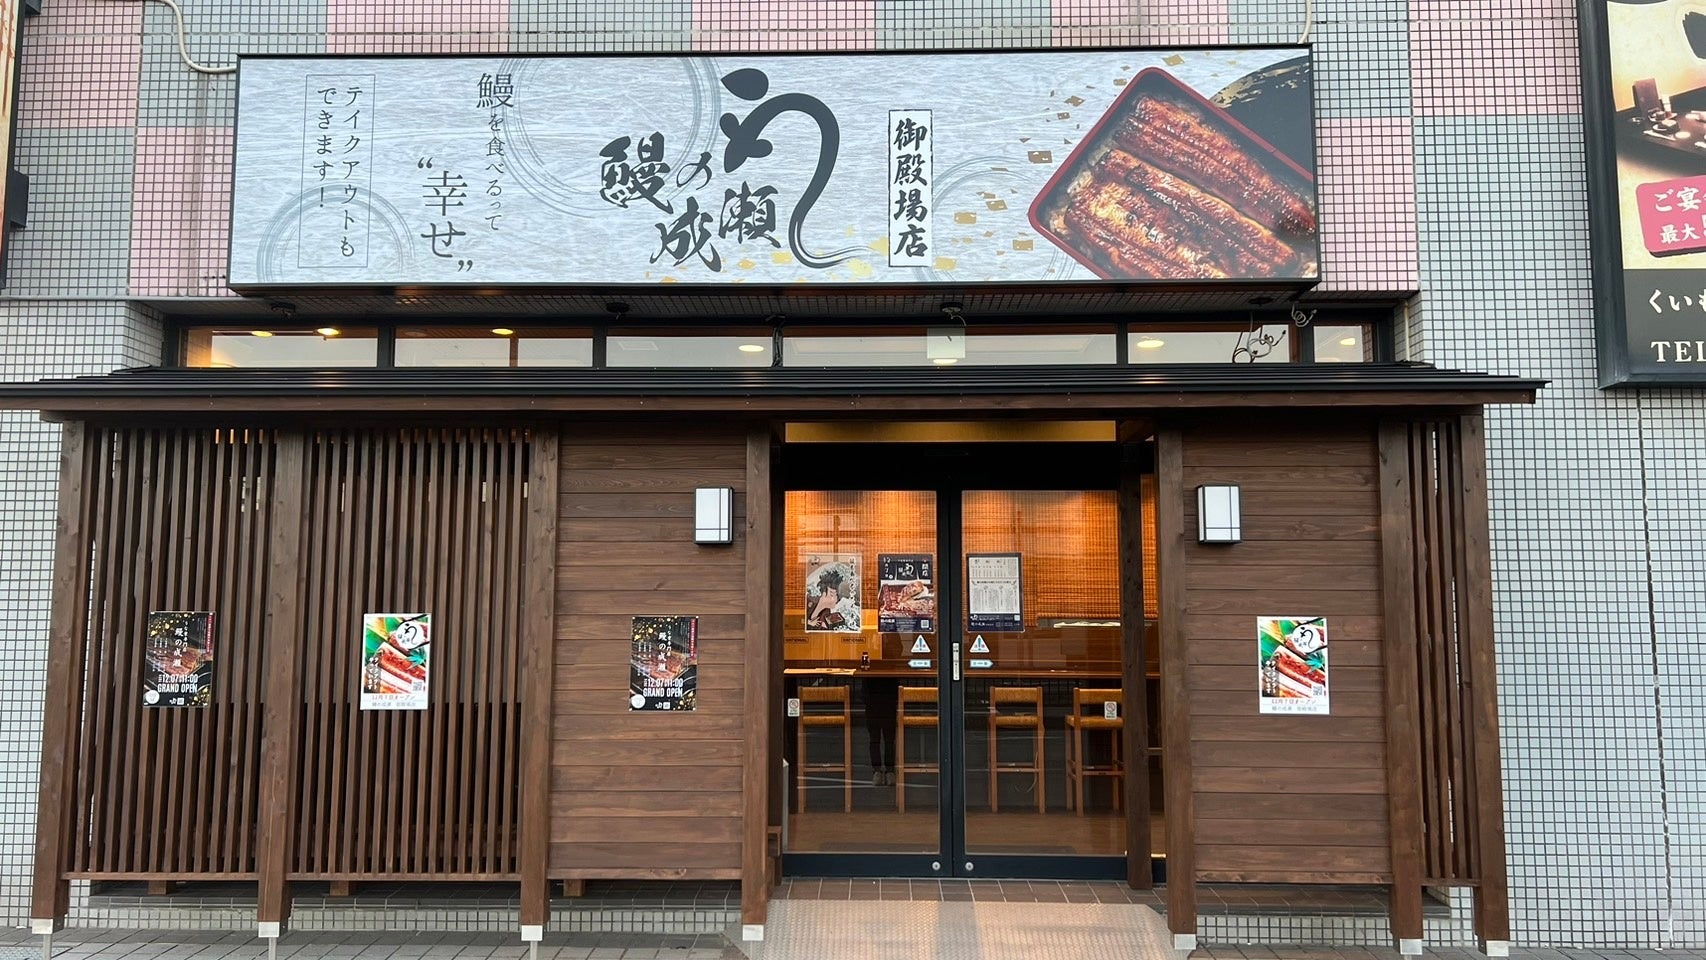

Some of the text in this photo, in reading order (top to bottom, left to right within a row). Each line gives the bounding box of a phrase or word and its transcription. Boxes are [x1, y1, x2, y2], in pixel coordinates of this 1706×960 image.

[313, 87, 337, 208] できます！
[339, 86, 363, 257] テイクアウトも
[477, 73, 514, 231] 鰻を食べるって
[599, 131, 781, 272] 鰻の成瀬
[894, 118, 928, 257] 御殿場店
[1654, 187, 1706, 212] ご宴
[1660, 214, 1706, 244] 最大
[157, 684, 198, 692] GRAND OPEN
[643, 688, 683, 697] GRAND OPEN
